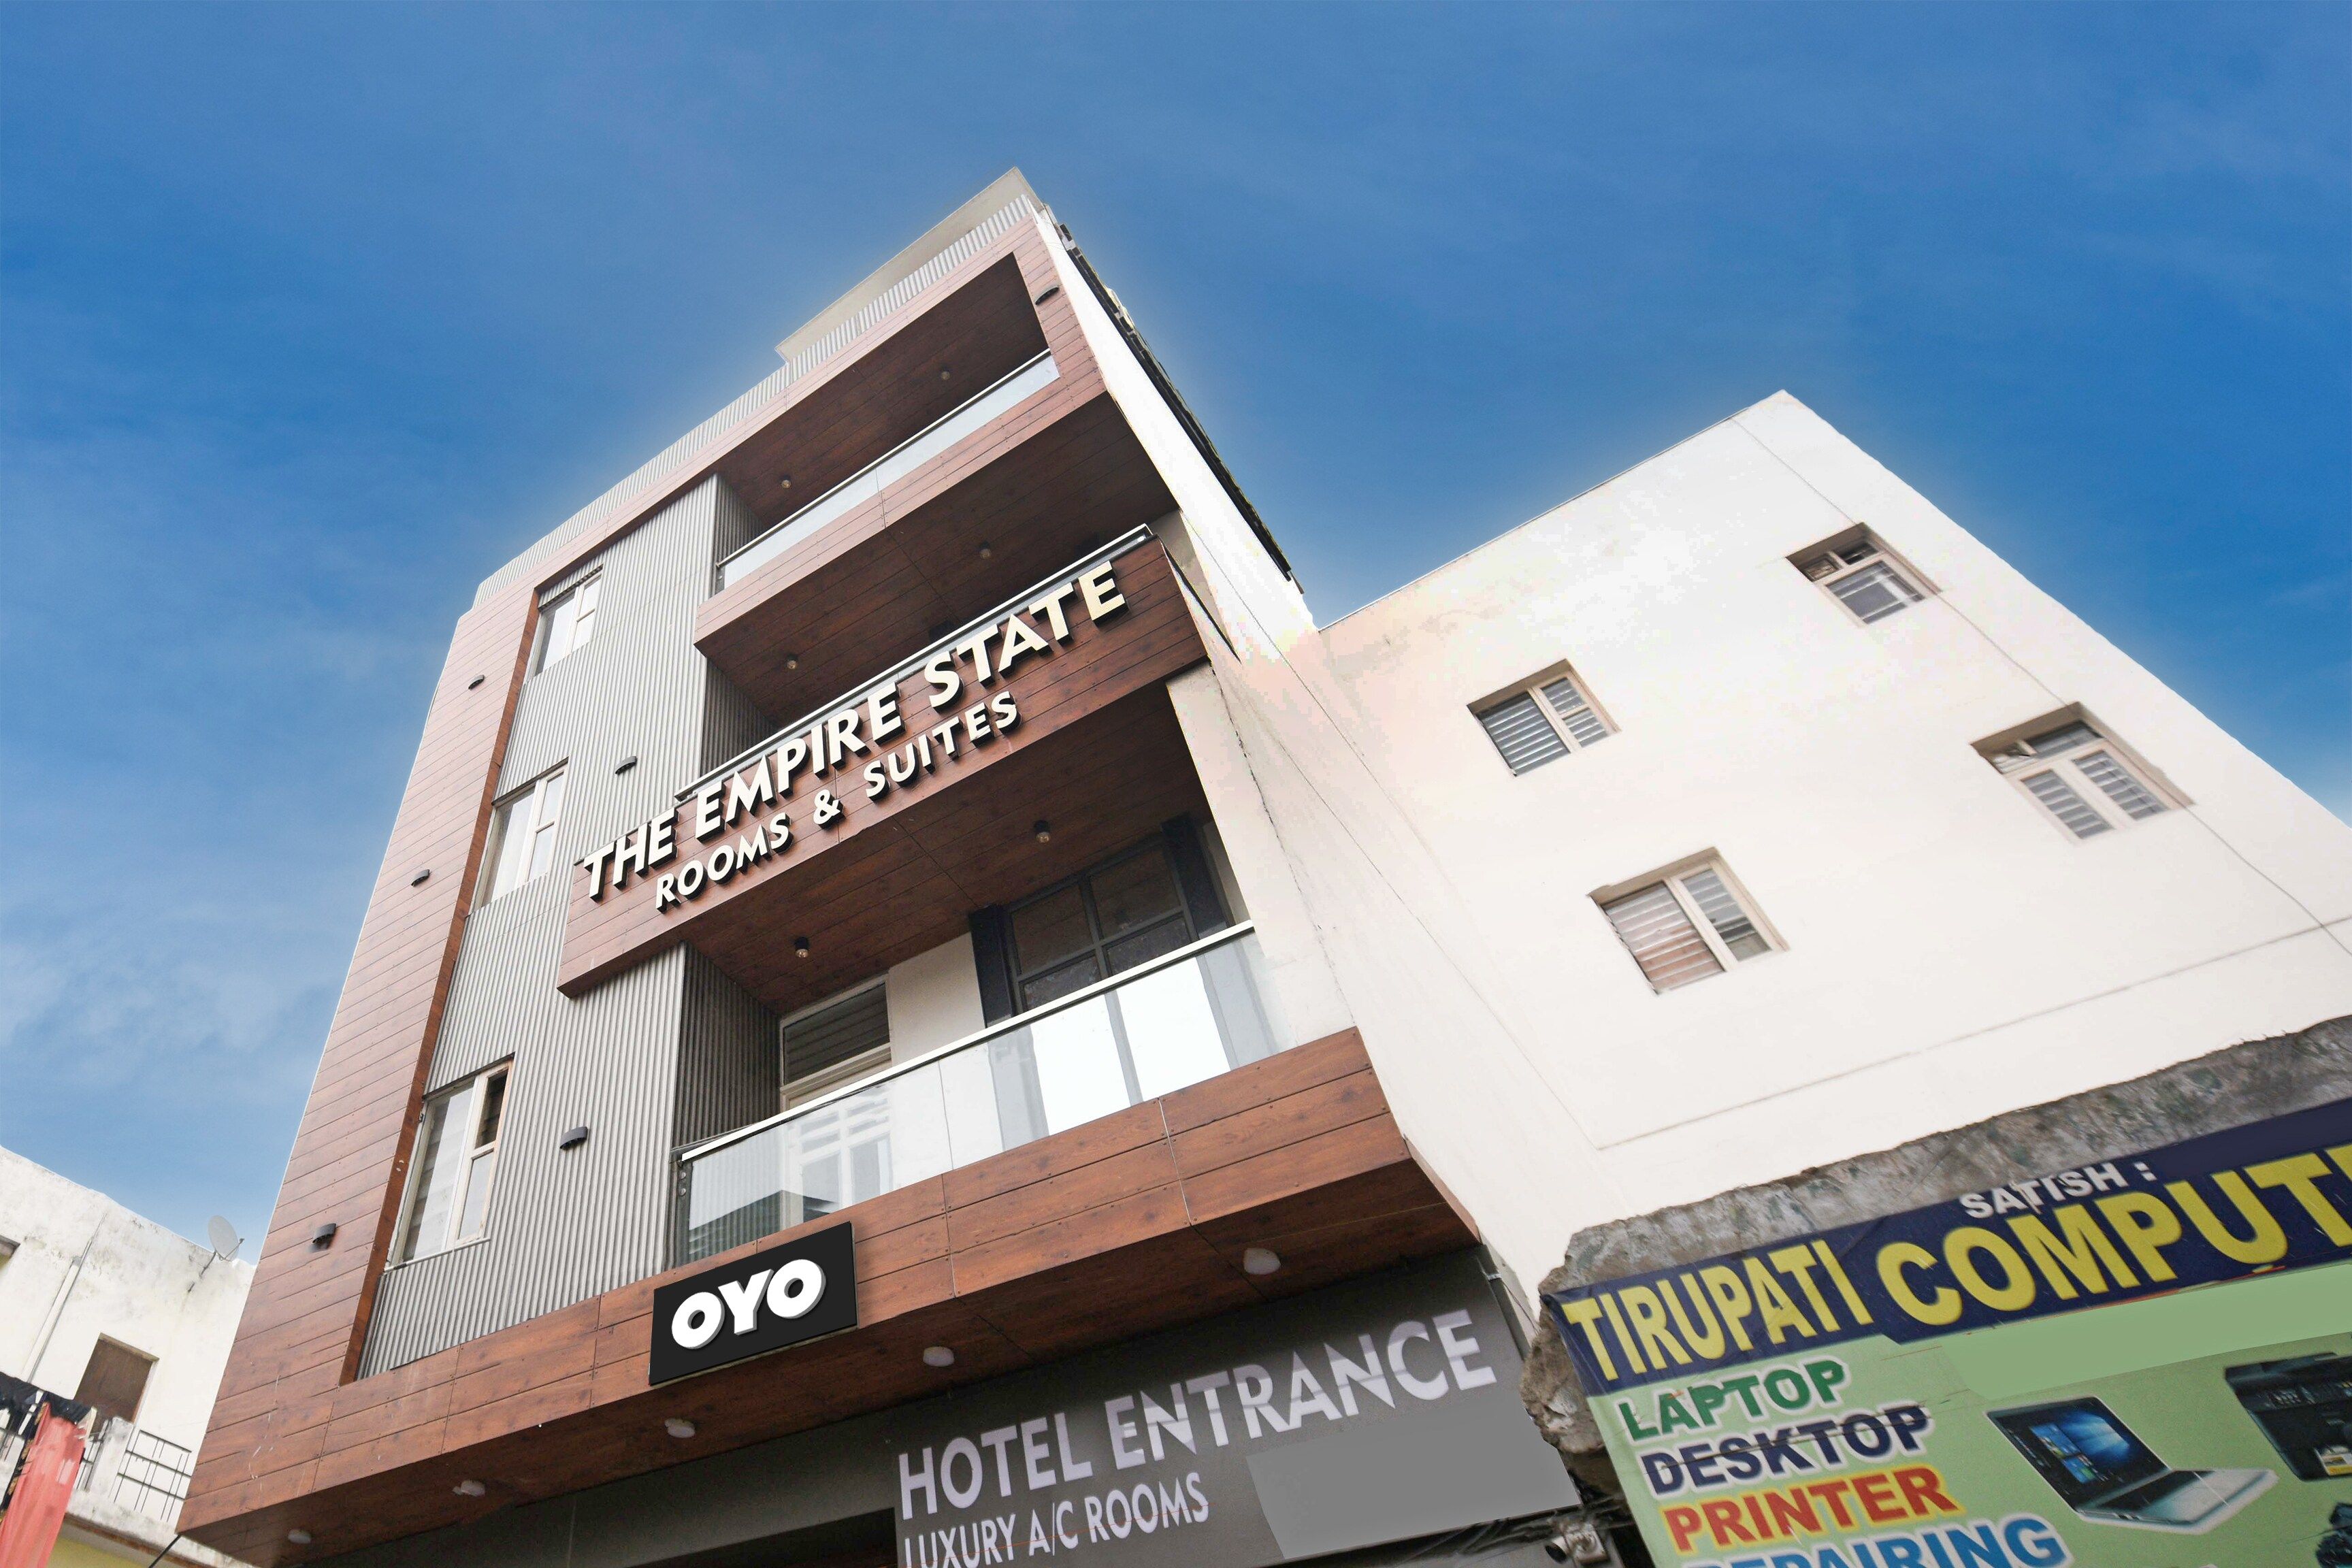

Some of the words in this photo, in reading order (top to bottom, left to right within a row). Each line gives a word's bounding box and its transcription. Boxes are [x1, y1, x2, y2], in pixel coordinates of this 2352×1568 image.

[583, 807, 678, 901] THE
[696, 682, 906, 842] EMPIRE
[924, 561, 1128, 714] STATE
[655, 813, 794, 914] ROOMS
[813, 789, 843, 830] &
[864, 691, 1022, 802] SUITES
[1959, 1162, 2128, 1219] SATISH
[672, 1259, 826, 1350] OYO
[1562, 1239, 1874, 1382] TIRUPATI
[898, 1412, 1093, 1520] HOTEL
[1105, 1309, 1497, 1471] ENTRANCE
[1618, 1359, 1845, 1441] LAPTOP
[1641, 1405, 1929, 1496] DESKTOP
[1028, 1500, 1079, 1556] A/C
[1084, 1471, 1209, 1544] ROOMS
[1663, 1467, 1960, 1552] PRINTER
